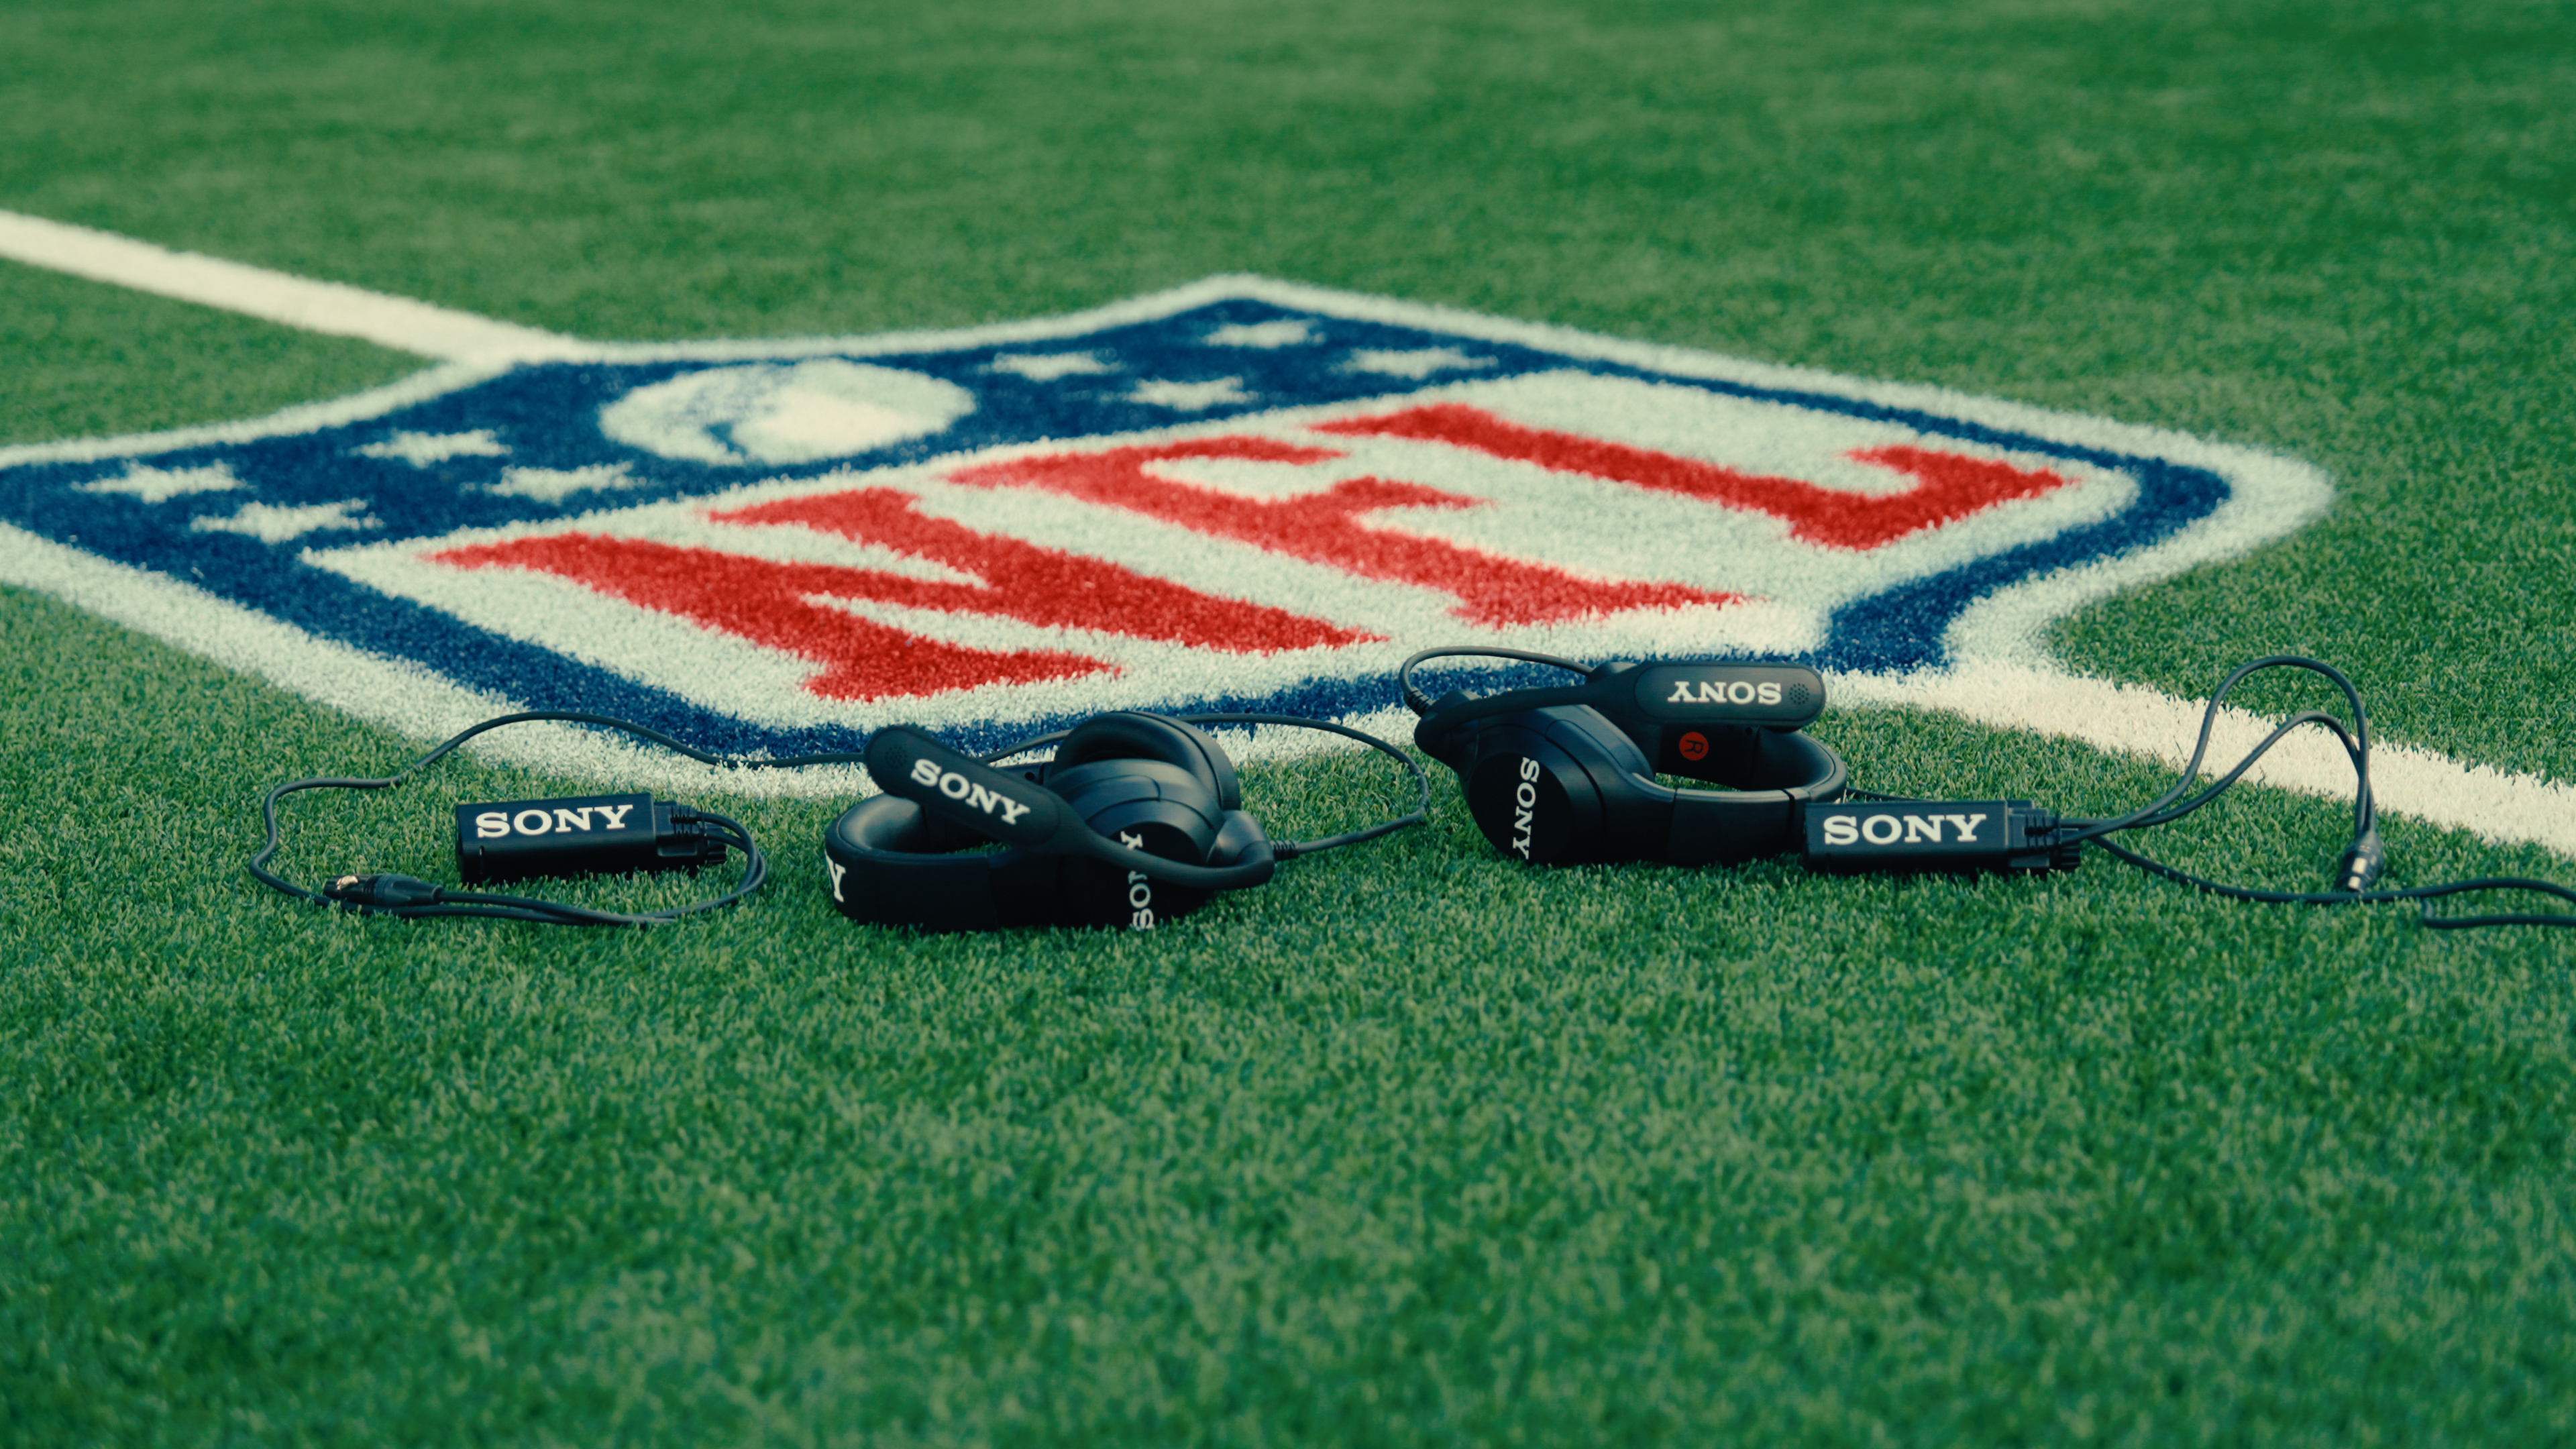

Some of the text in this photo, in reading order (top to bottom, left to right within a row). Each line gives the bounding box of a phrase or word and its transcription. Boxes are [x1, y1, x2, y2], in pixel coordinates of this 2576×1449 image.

[428, 401, 2066, 704] NFL
[1667, 681, 1782, 705] SONY
[1684, 739, 1704, 754] R
[910, 758, 1031, 825] SONY
[1513, 757, 1540, 859] SONY
[475, 804, 633, 839] SONY
[1823, 813, 1988, 846] SONY
